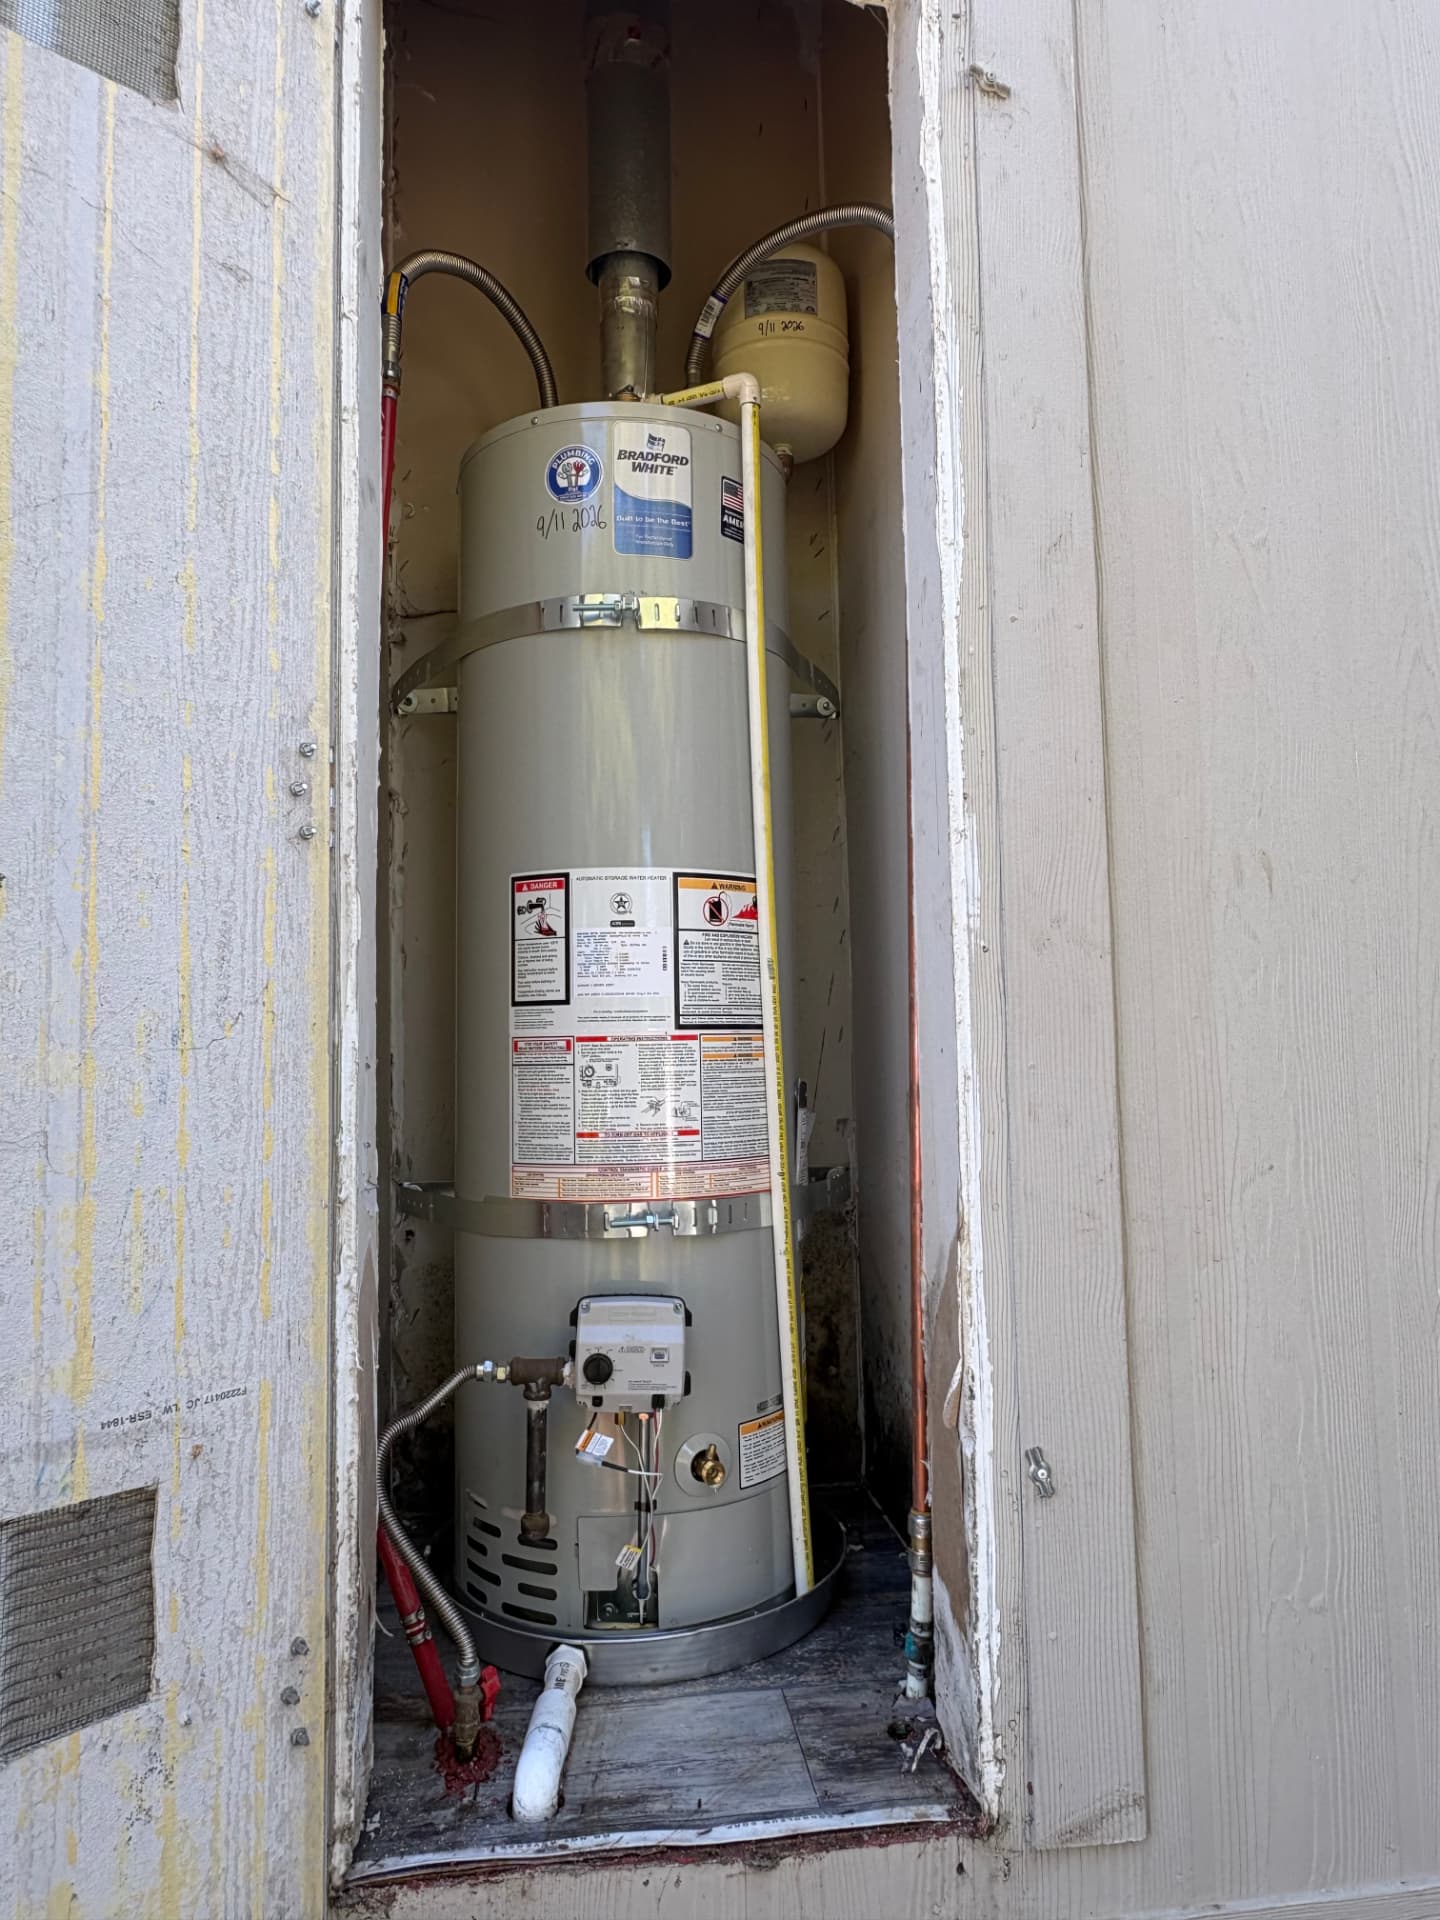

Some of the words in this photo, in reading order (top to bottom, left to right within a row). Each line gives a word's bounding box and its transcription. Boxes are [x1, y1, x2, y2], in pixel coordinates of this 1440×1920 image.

[758, 320, 775, 336] 9/11
[781, 321, 805, 332] 2026
[552, 449, 595, 470] PLUMBING
[617, 449, 690, 466] BRADFORD
[631, 462, 675, 476] WHITE
[536, 509, 566, 540] 9/11
[572, 505, 608, 532] 2026
[657, 516, 670, 524] the
[530, 882, 558, 890] DANGER
[204, 1386, 248, 1404] F2220417
[185, 1399, 200, 1410] JC
[100, 1410, 152, 1430] ESR-1844
